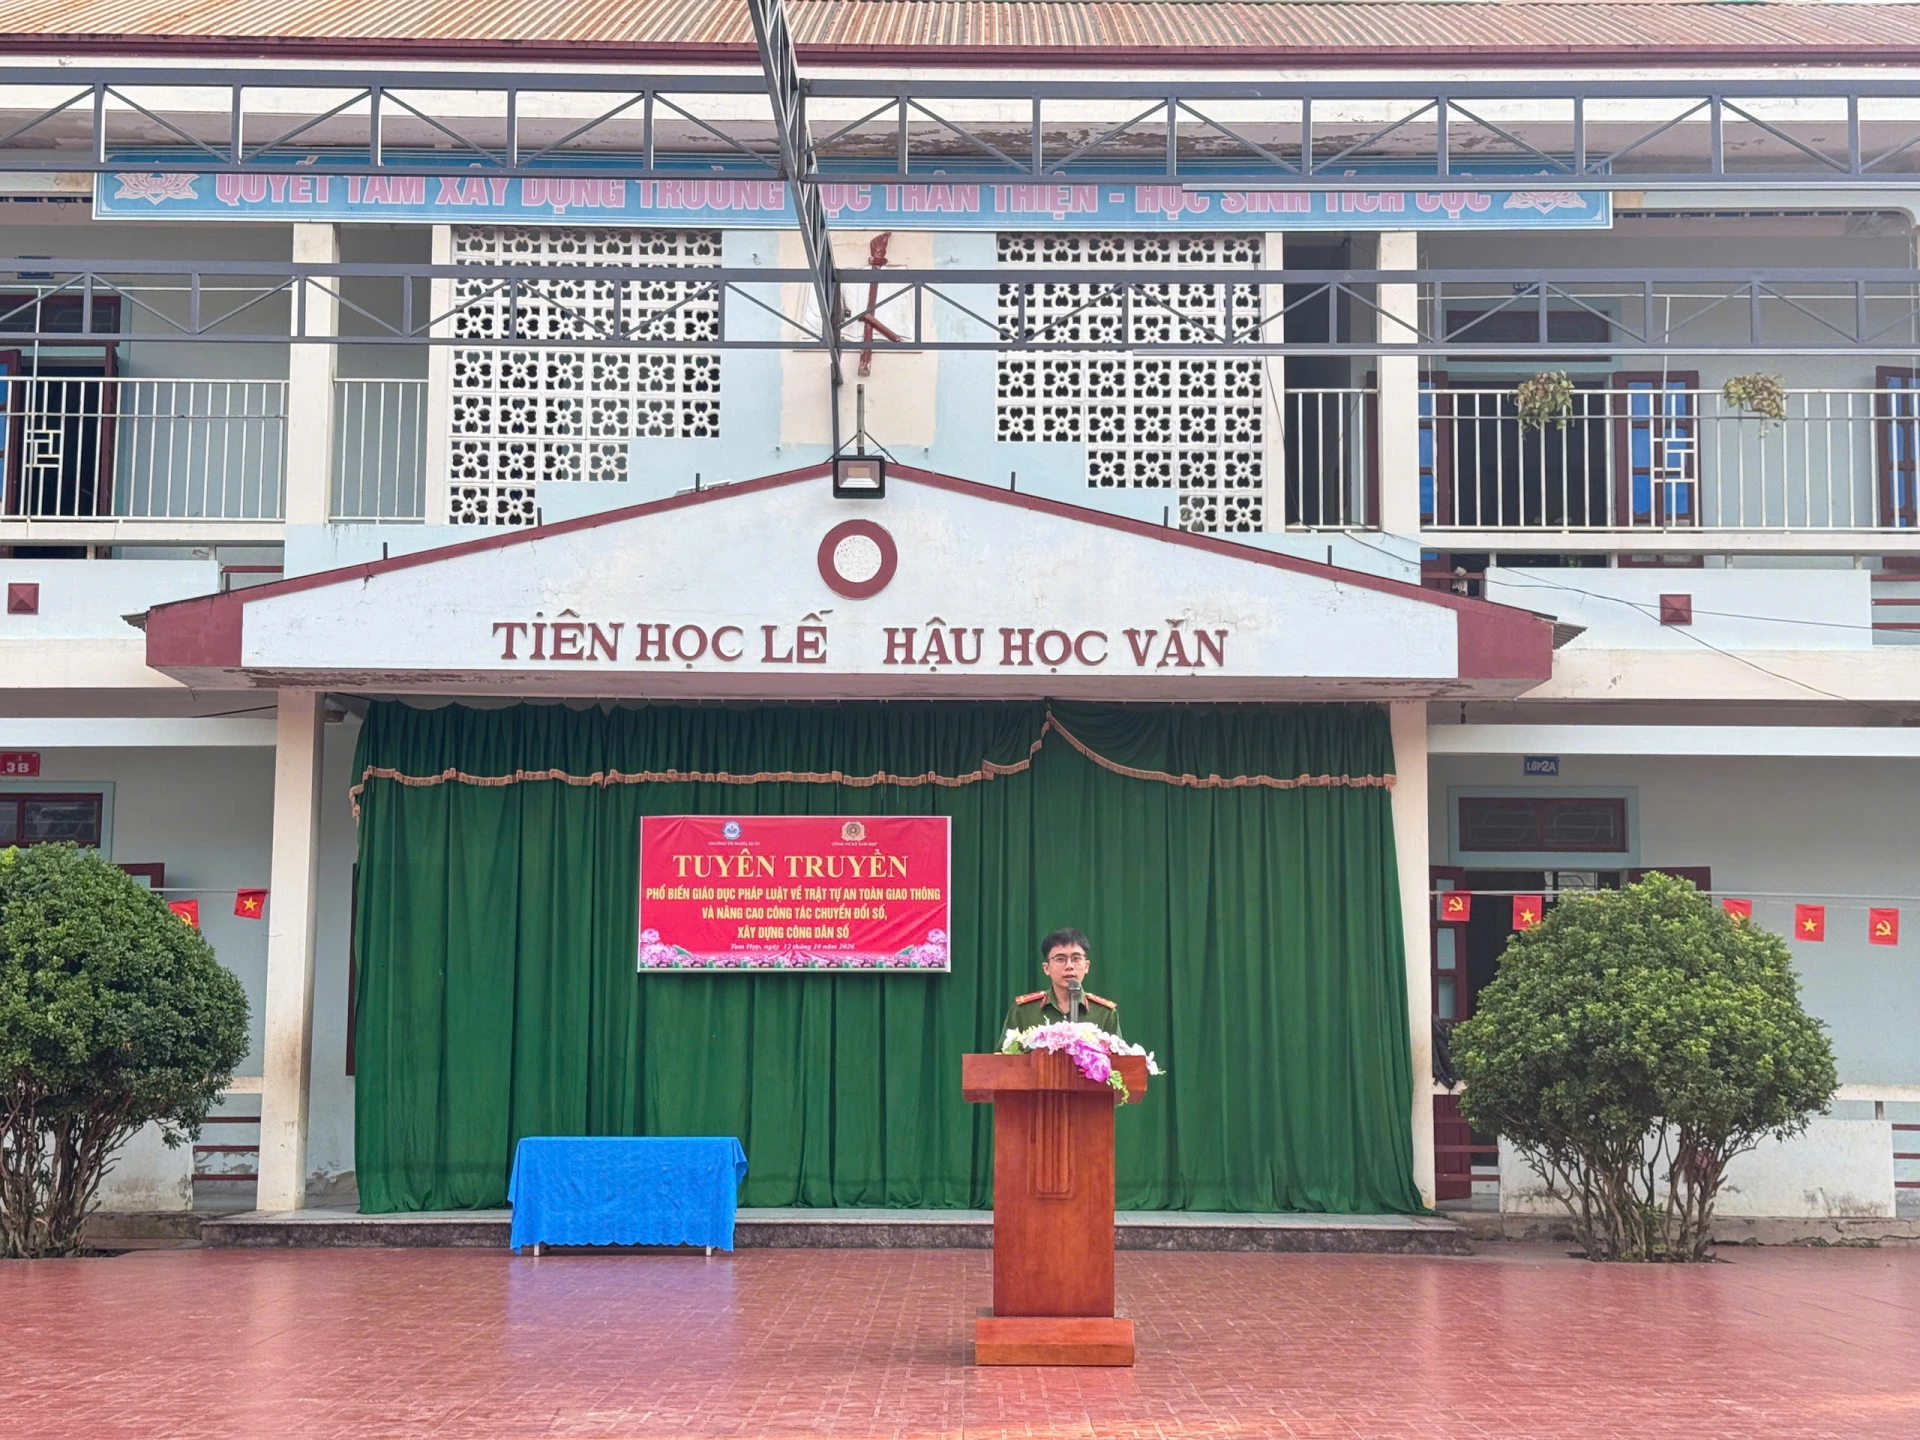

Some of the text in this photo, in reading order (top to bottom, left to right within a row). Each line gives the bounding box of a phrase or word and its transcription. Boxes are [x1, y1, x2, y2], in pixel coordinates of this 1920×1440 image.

[635, 624, 744, 669] HỌC
[883, 616, 985, 672] HẬU
[999, 628, 1108, 674] HỌC
[1122, 618, 1229, 668] VĂN
[672, 848, 909, 879] TUYÊN TRUYỀN
[646, 883, 666, 900] PHỔ
[667, 884, 690, 900] BIẾN
[692, 885, 715, 900] GIÁO
[716, 887, 736, 902] DỤC
[738, 885, 763, 900] PHÁP
[765, 885, 788, 902] LUẬT
[804, 886, 827, 903] TRẬT
[829, 887, 842, 903] TỰ
[843, 888, 857, 900] AN
[858, 886, 884, 900] TOÀN
[886, 888, 908, 900] GIAO
[910, 886, 941, 900] THÔNG
[702, 904, 714, 919] VÀ
[716, 905, 744, 919] NÂNG
[745, 907, 764, 919] CAO
[766, 905, 792, 919] CÔNG
[794, 905, 812, 919] TÁC
[737, 922, 850, 941] XÂY DỰNG CÔNG DÂN SỐ
